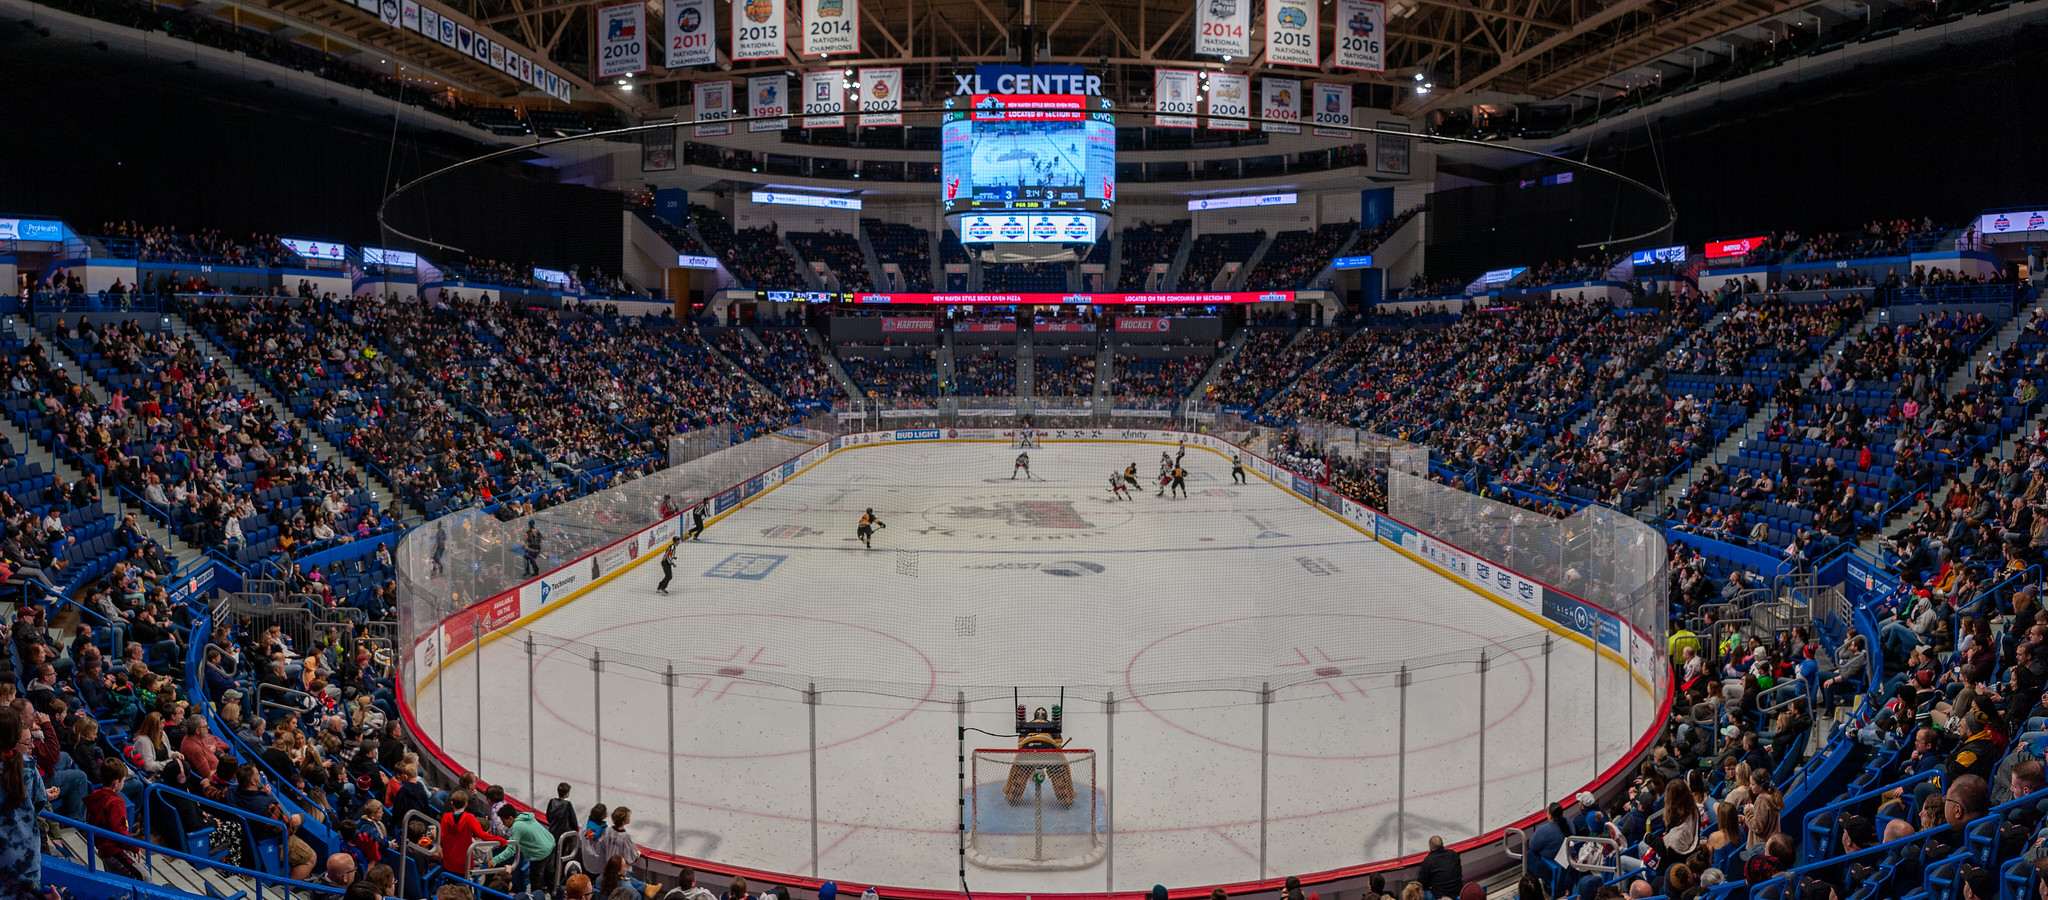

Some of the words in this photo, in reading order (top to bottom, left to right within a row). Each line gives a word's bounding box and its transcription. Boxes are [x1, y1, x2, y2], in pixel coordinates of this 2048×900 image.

[810, 20, 852, 35] 2014
[1202, 22, 1243, 38] 2014
[739, 25, 778, 41] 2013
[673, 33, 707, 50] 2011
[812, 36, 850, 44] NATIONAL
[1204, 38, 1241, 47] NATIONAL
[1273, 31, 1311, 47] 2015
[476, 37, 488, 59] G
[740, 41, 776, 49] NATIONAL
[809, 44, 853, 53] CHAMPIONS
[1342, 37, 1379, 54] 2016
[604, 42, 641, 59] 2010
[673, 49, 707, 58] NATIONAL
[738, 49, 780, 58] CHAMPIONS
[1201, 46, 1244, 55] CHAMPIONS
[1275, 47, 1310, 56] NATIONAL
[606, 57, 638, 67] NATIONAL
[670, 57, 711, 66] CHAMPIONS
[1272, 54, 1313, 64] CHAMPIONS
[1344, 52, 1377, 62] NATIONAL
[603, 64, 642, 75] CHAMPIONS
[1340, 59, 1380, 70] CHAMPIONS
[548, 76, 557, 94] V
[955, 74, 990, 96] XL
[997, 74, 1102, 95] CENTER
[561, 83, 569, 99] X
[806, 102, 841, 114] 2000
[863, 100, 898, 112] 2002
[1160, 101, 1193, 113] 2003
[1212, 104, 1246, 116] 2004
[699, 111, 728, 121] 1995
[753, 106, 783, 117] 1999
[1264, 108, 1298, 120] 2004
[1316, 112, 1349, 125] 2009
[753, 123, 784, 131] CHAMPIONS
[1212, 121, 1246, 129] CHAMPIONS
[1005, 190, 1012, 200] 3
[1025, 189, 1040, 198] 9:14
[1046, 190, 1054, 200] 3
[667, 200, 678, 208] 220
[829, 199, 848, 207] UNITED
[28, 223, 59, 232] ProHealth
[688, 257, 709, 267] xfinity
[1836, 261, 1848, 269] 105
[201, 265, 212, 273] 114
[896, 320, 934, 330] HARTFORD
[1120, 320, 1153, 330] HOCKEY
[896, 431, 913, 439] BUD
[914, 430, 939, 439] LIGHT
[1056, 430, 1067, 438] XL
[1074, 430, 1085, 438] XL
[1091, 430, 1102, 438] XL
[1121, 430, 1148, 440] xfinity
[1476, 562, 1490, 576] CPE
[551, 574, 576, 591] Technology
[1497, 571, 1512, 586] CPE
[1518, 580, 1534, 596] CPE
[493, 595, 514, 610] AVAILABLE
[496, 609, 504, 617] ON
[503, 605, 511, 614] THE
[492, 611, 515, 628] CONCOURSE
